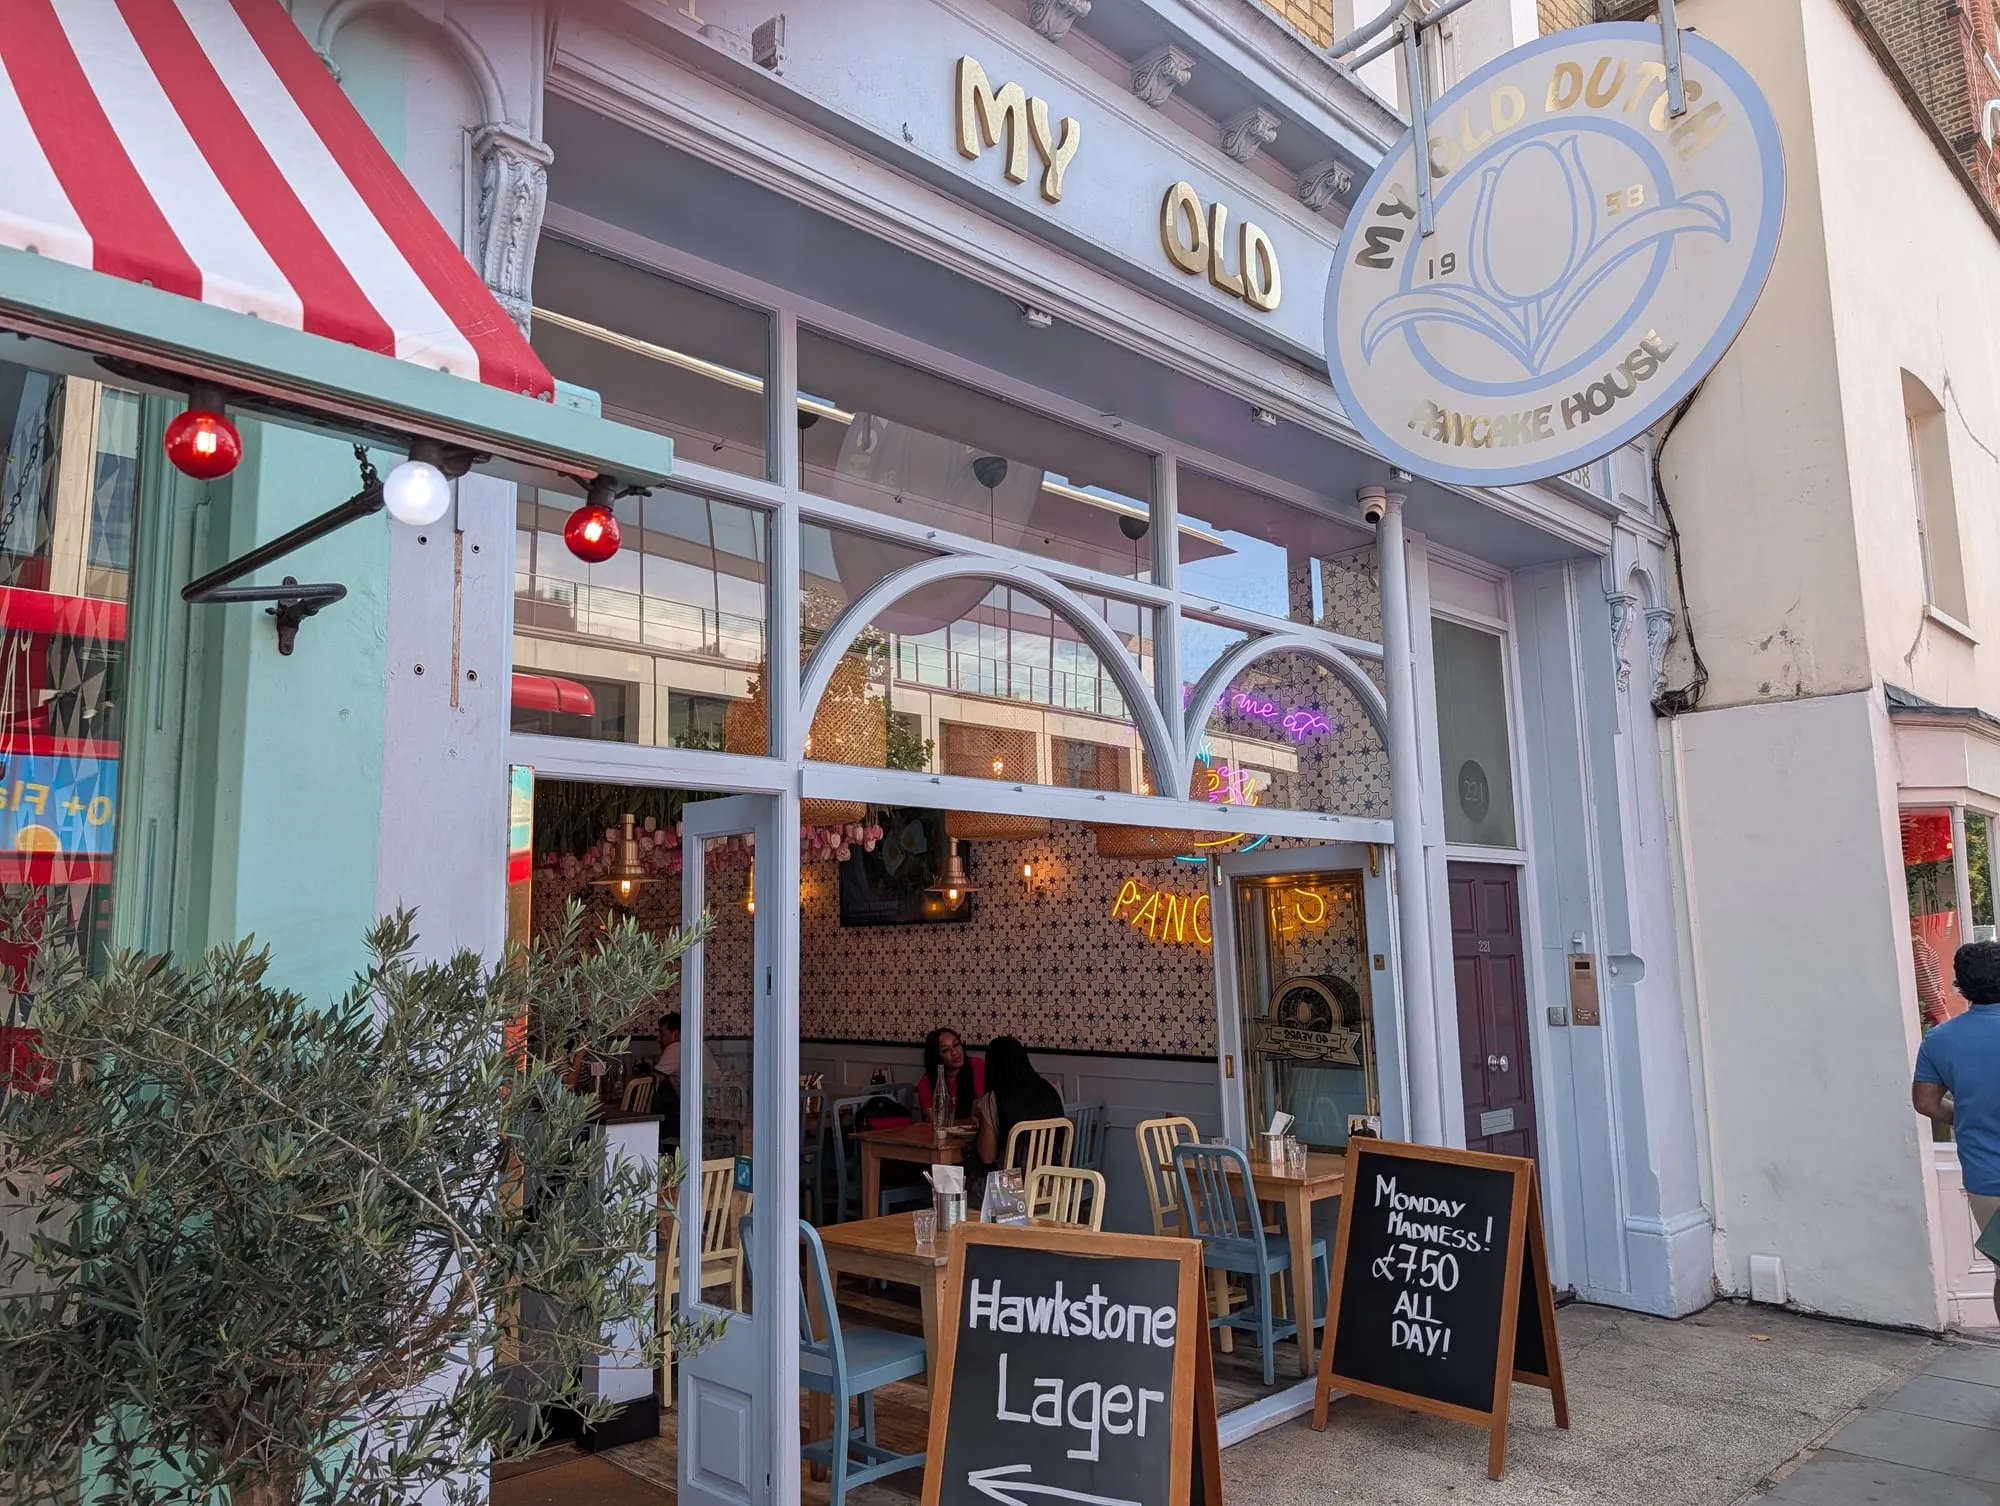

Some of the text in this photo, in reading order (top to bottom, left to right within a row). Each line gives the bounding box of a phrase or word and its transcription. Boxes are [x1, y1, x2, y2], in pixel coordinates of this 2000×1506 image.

[955, 54, 1282, 312] MY OLD
[1355, 56, 1731, 269] MY OLD DUTCH
[1428, 183, 1644, 280] 19 58
[1407, 328, 1679, 449] PANCAKE HOUSE
[1464, 780, 1484, 804] 221
[969, 1278, 1177, 1347] Hawkstone
[1391, 1320, 1451, 1360] DAY!
[1392, 1290, 1443, 1325] ALL
[997, 1353, 1164, 1461] Lager
